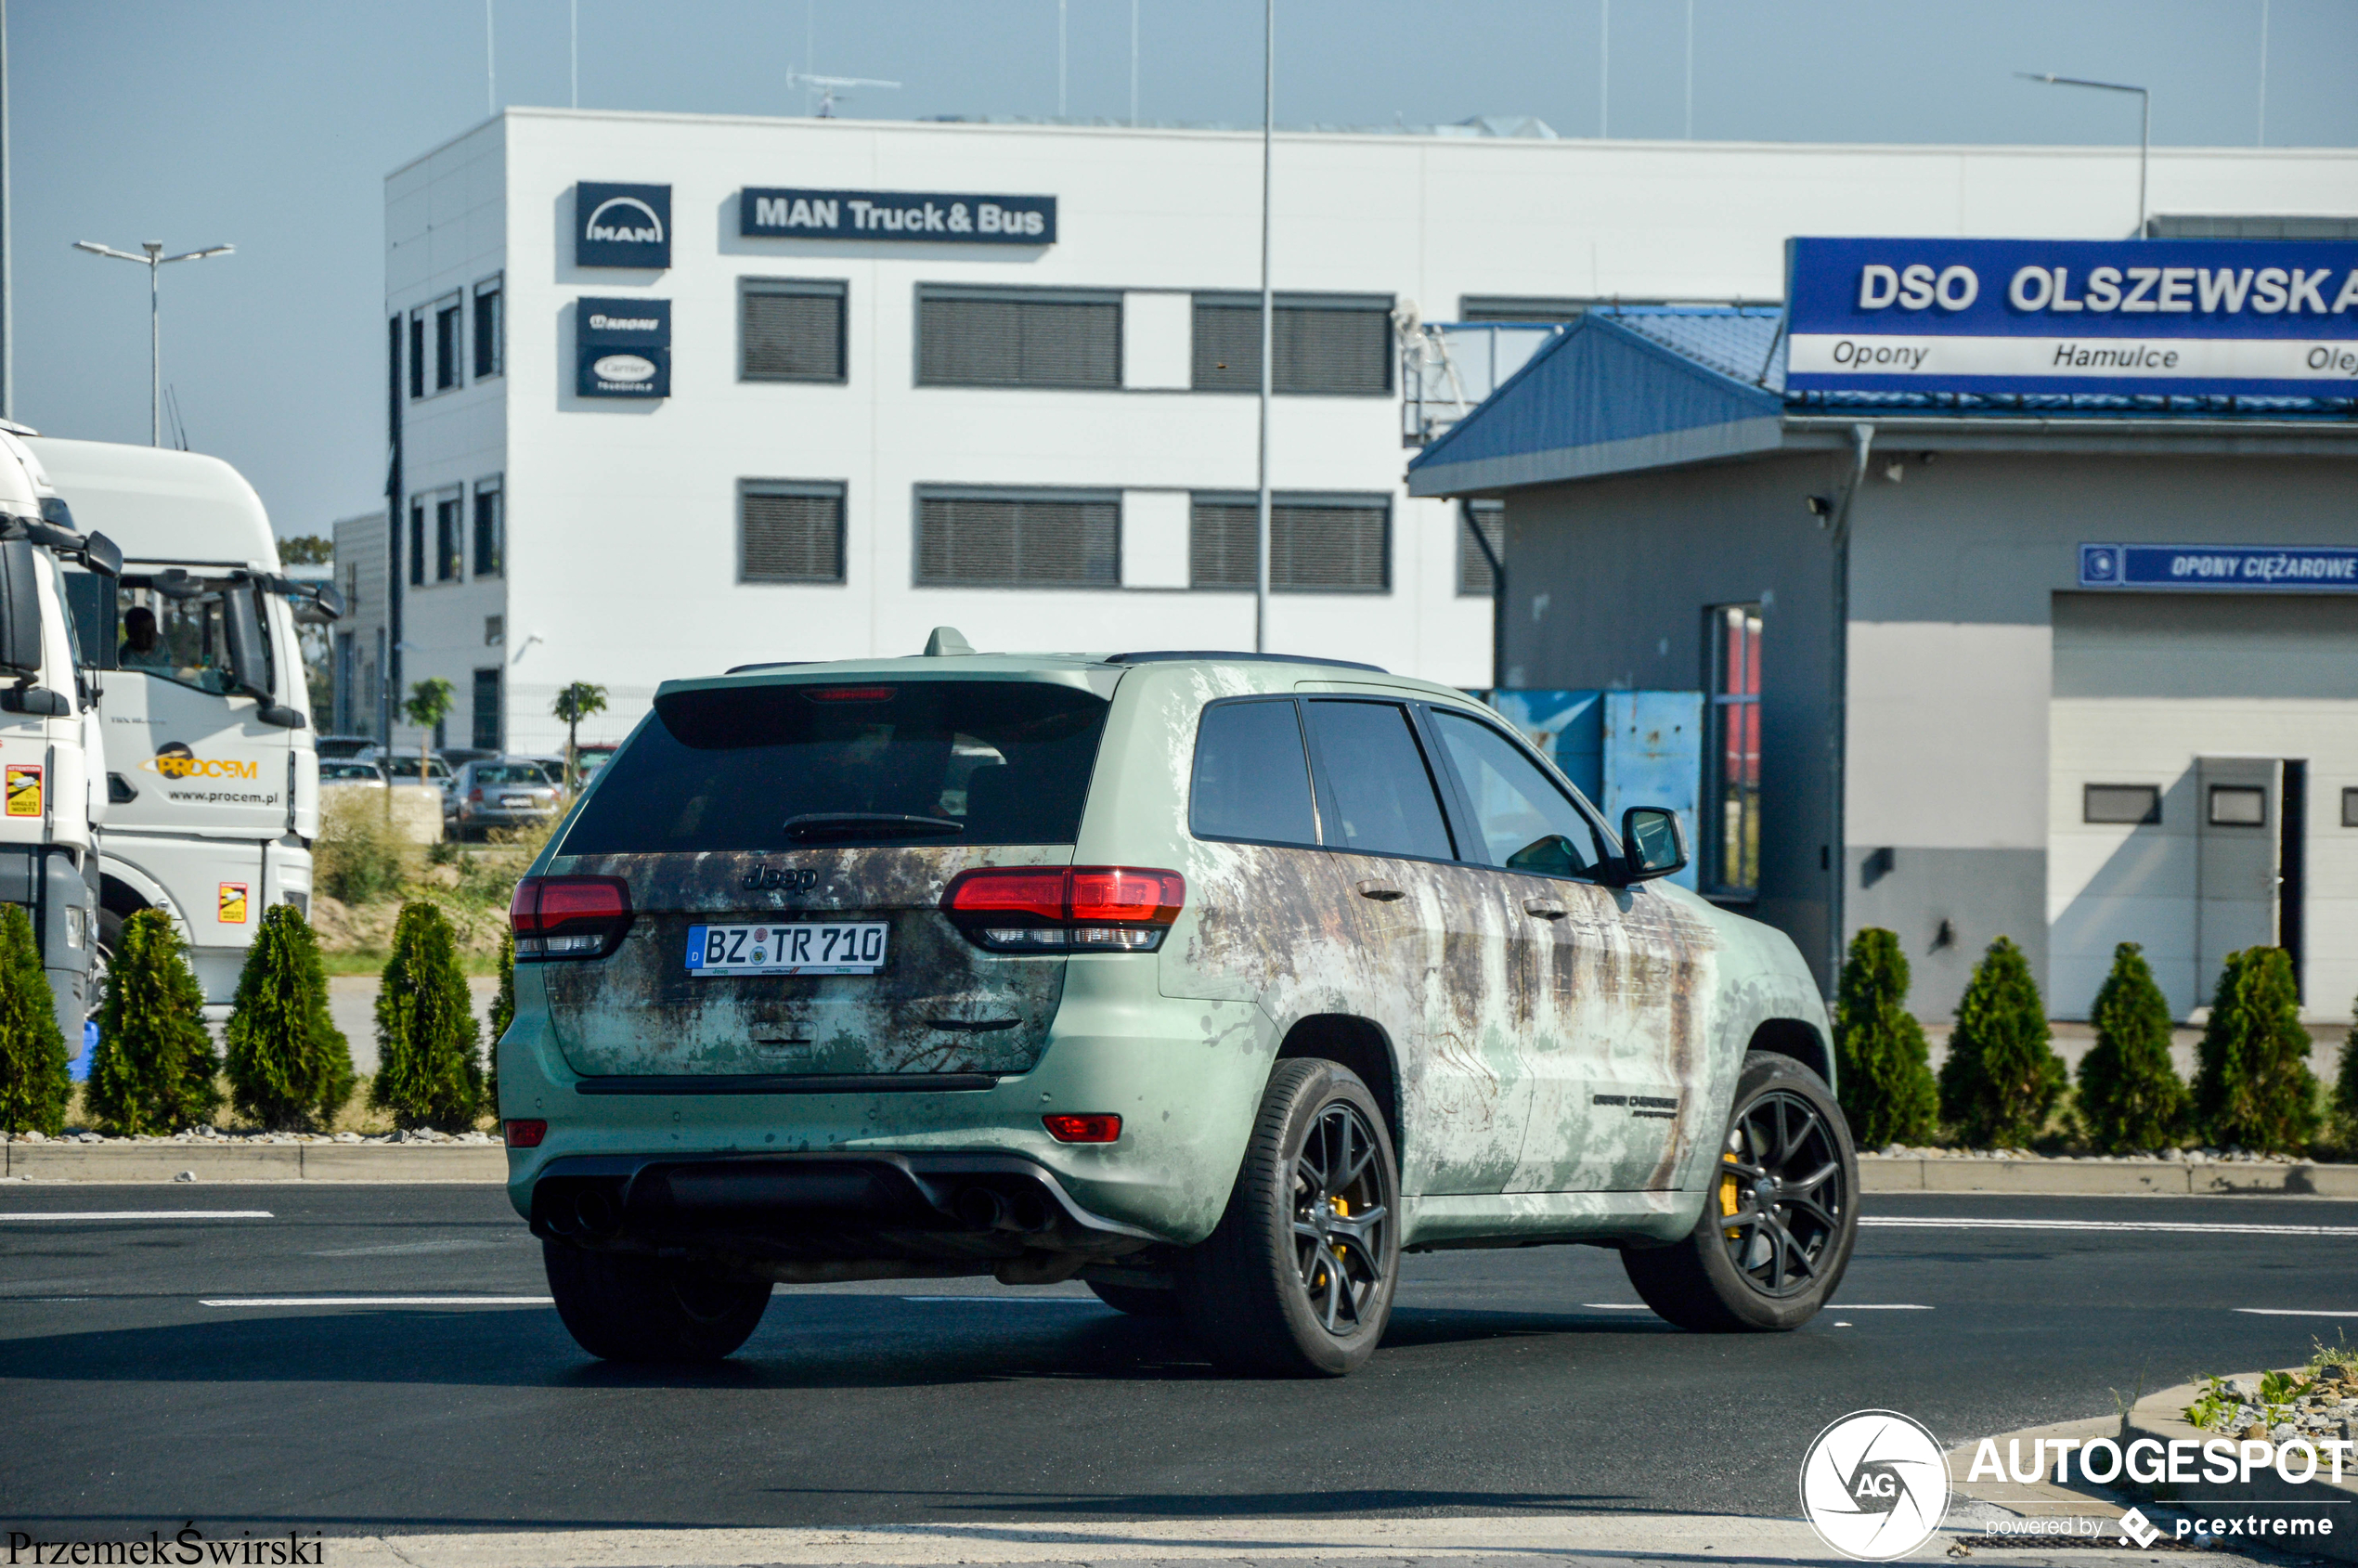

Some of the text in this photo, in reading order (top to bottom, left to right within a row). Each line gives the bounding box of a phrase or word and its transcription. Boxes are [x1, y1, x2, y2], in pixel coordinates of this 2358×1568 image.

[756, 197, 1044, 235] MAN Truck & Bus
[594, 226, 655, 242] MAN
[1859, 265, 1979, 311] DSO
[1832, 340, 1929, 367] Opony
[2053, 343, 2179, 369] Hamulce
[2172, 553, 2358, 581] OPONY CIĘŻAROWE
[158, 757, 258, 779] PROCEM
[169, 790, 279, 806] www.procem.pl
[742, 863, 818, 895] Jeep
[692, 952, 699, 962] D
[706, 927, 883, 964] BZ TR 710
[835, 965, 851, 974] Jeep
